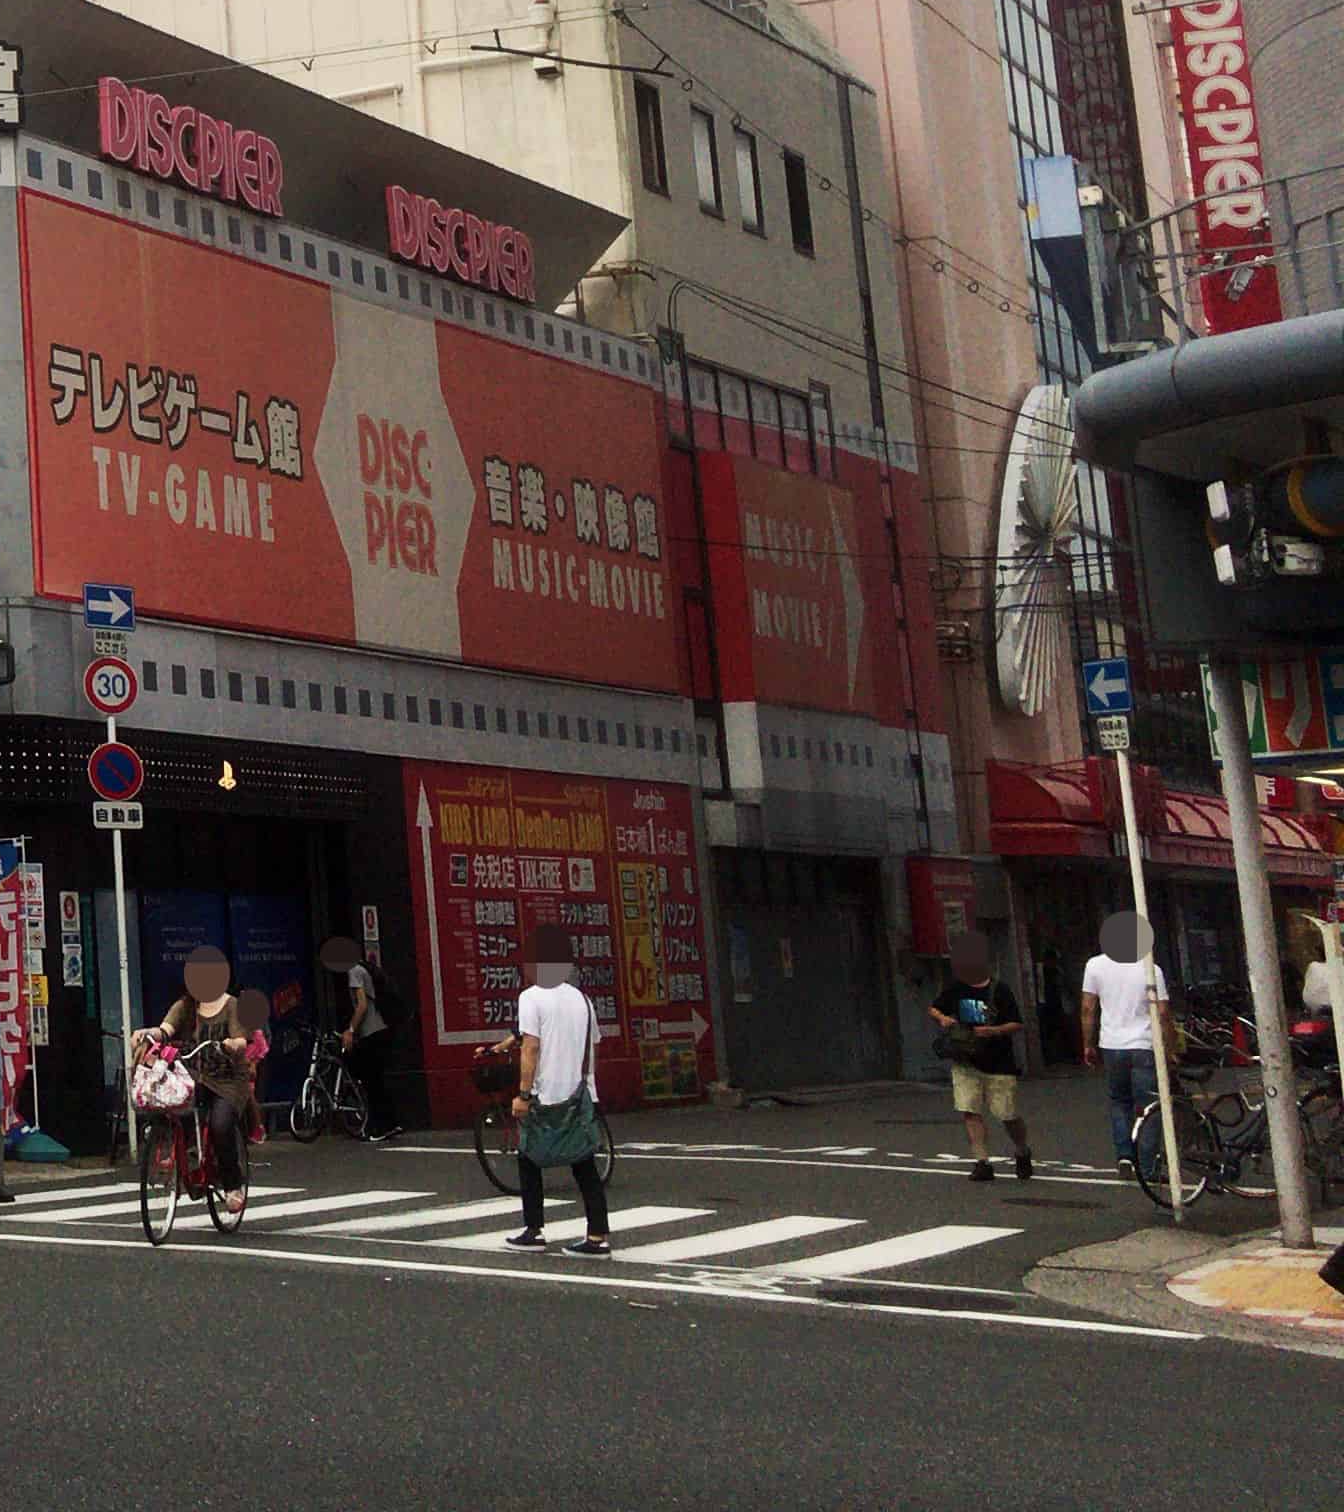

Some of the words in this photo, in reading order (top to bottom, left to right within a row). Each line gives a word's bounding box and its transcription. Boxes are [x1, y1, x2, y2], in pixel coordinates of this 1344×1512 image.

[48, 342, 305, 483] テレビゲーム館
[483, 455, 664, 563] 音楽・映像館
[363, 488, 440, 580] PIER
[97, 672, 127, 699] 30
[95, 807, 141, 823] 自動車
[473, 853, 515, 889] 免税店
[518, 859, 562, 889] TAX-FREE
[478, 933, 518, 958] ミニカー
[483, 997, 520, 1024] ラジコ
